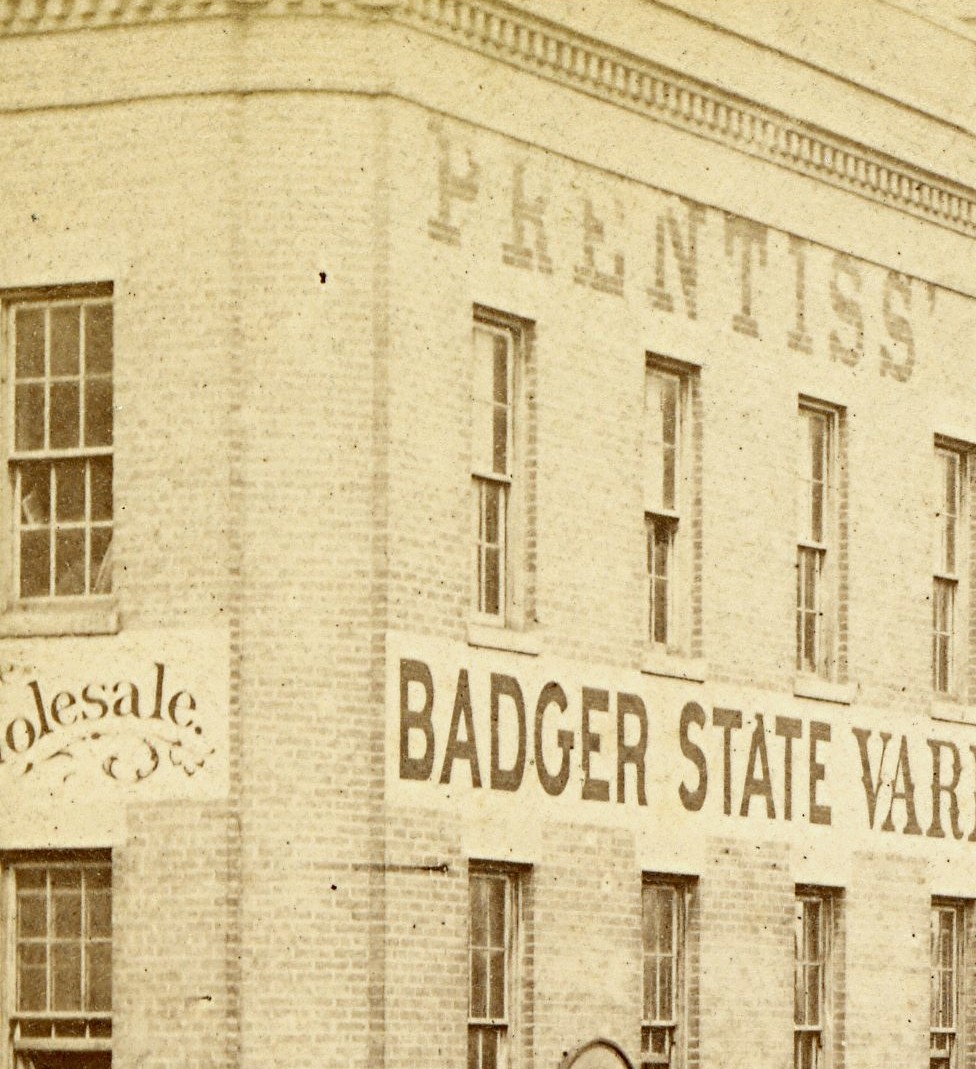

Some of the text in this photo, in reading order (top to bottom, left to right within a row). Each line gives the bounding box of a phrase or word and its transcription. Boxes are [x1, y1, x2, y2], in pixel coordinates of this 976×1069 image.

[2, 662, 202, 756] olesale.
[398, 657, 648, 807] BADGER
[677, 699, 832, 826] STATE
